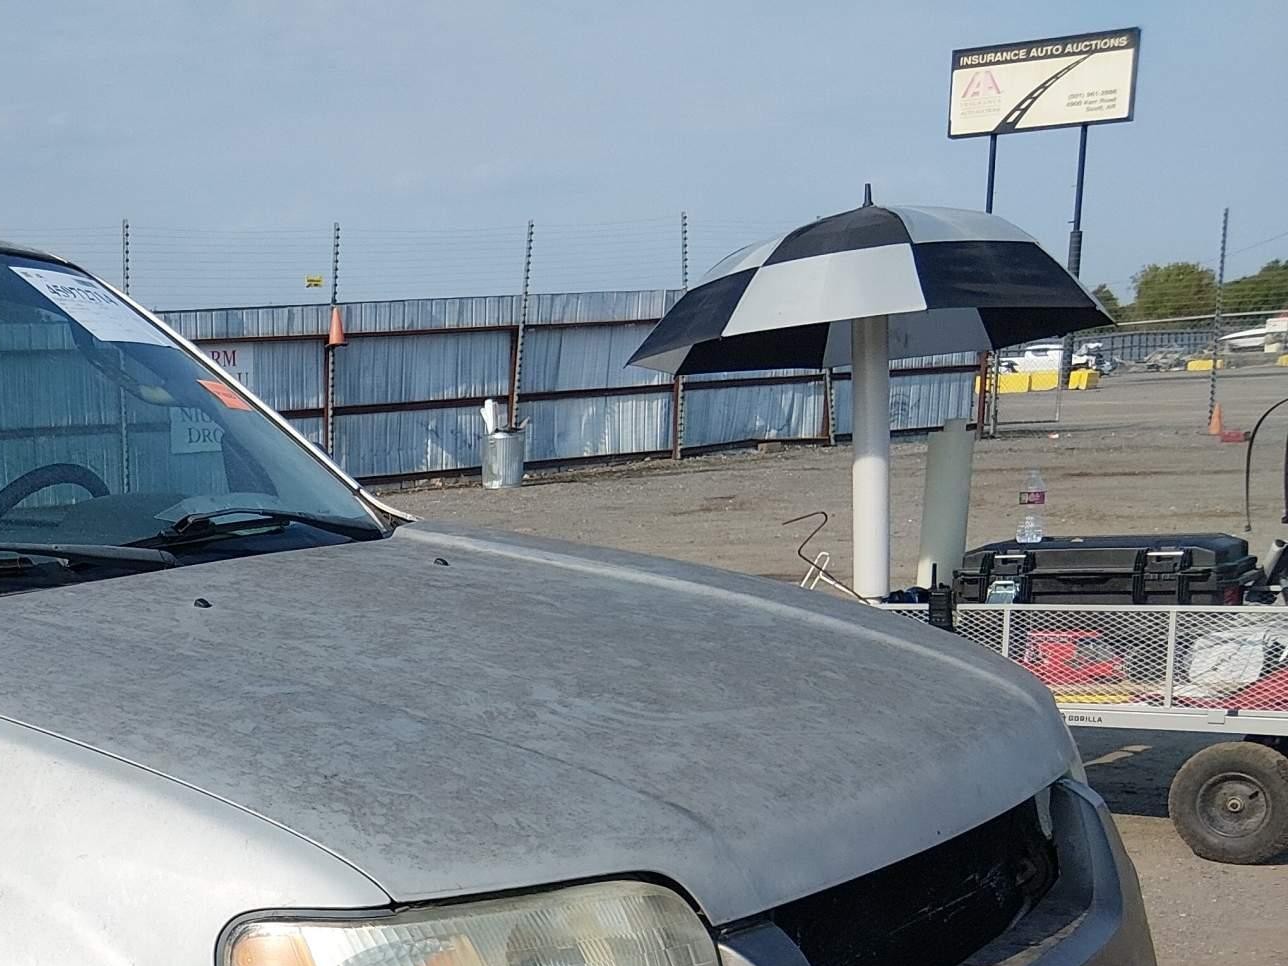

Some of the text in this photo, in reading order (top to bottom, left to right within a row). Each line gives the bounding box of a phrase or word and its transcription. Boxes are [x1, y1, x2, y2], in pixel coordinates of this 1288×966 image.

[960, 36, 1128, 66] INSURANCE AUTO AUCTIONS
[209, 350, 236, 367] RM
[188, 427, 223, 444] DRO
[1068, 715, 1103, 723] GORILLA
